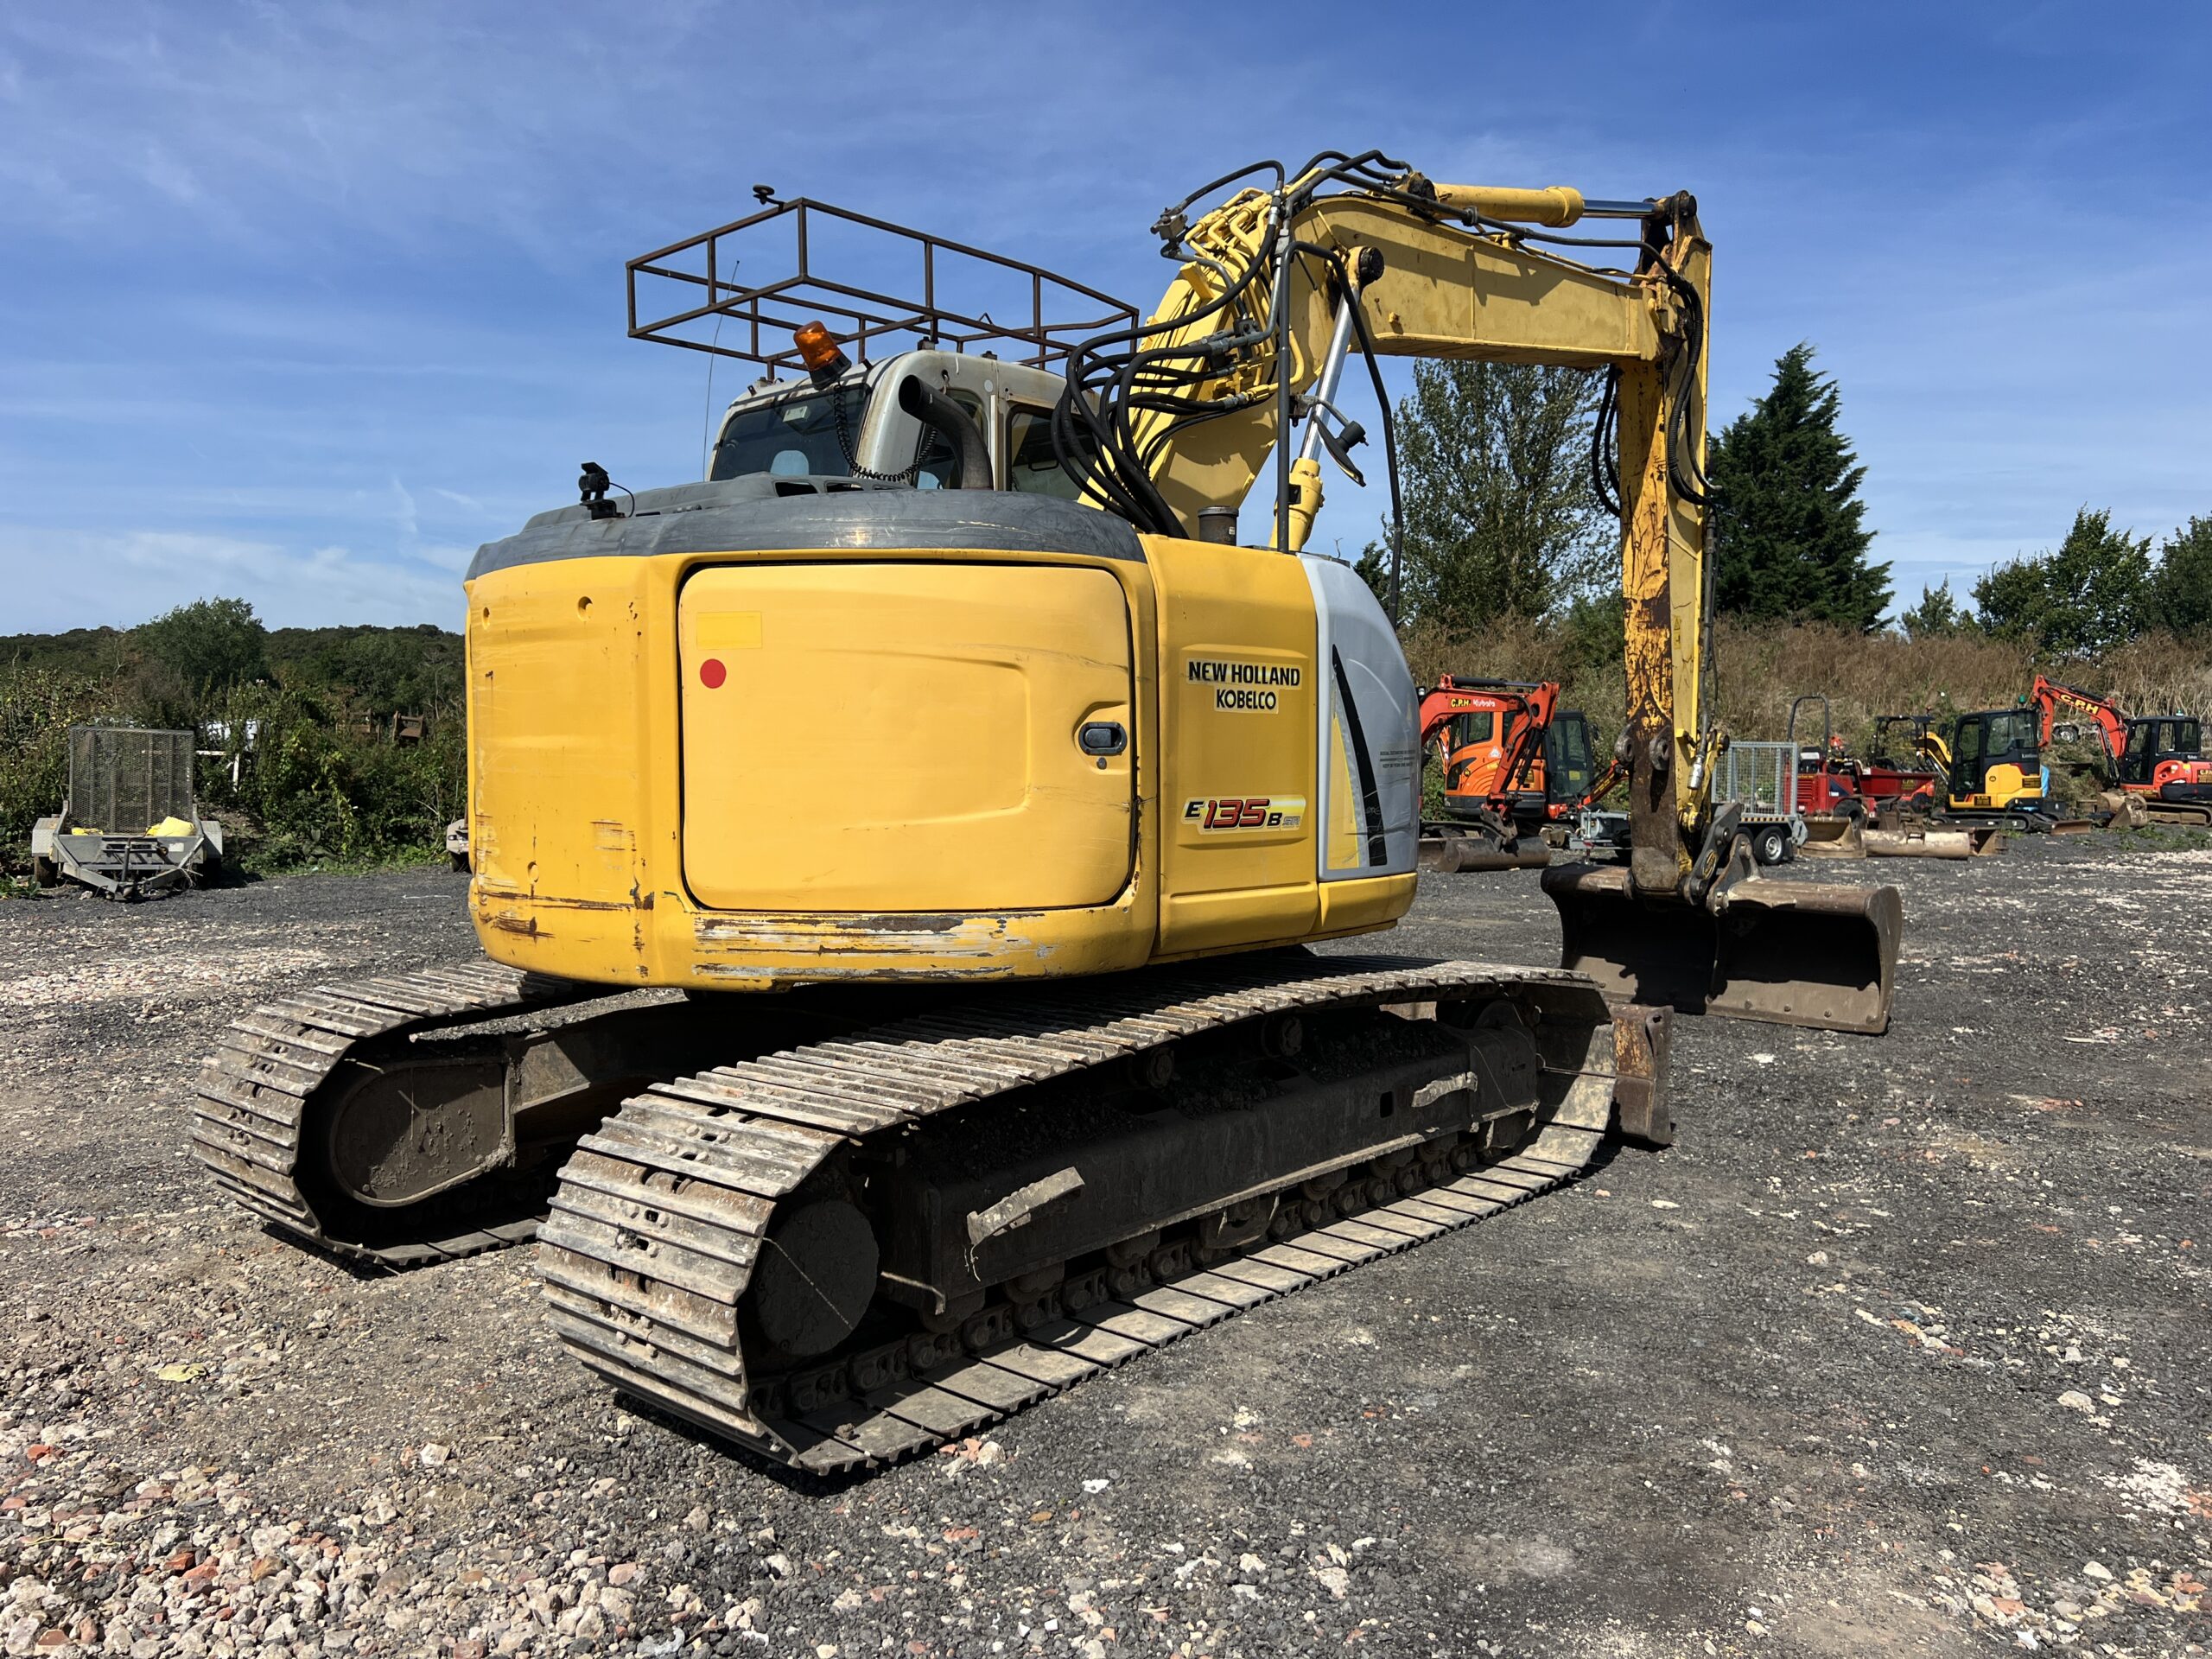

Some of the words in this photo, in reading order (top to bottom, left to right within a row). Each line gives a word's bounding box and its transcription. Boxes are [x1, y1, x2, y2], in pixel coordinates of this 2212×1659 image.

[1188, 661, 1227, 682] NEW
[1231, 664, 1300, 686] HOLLAND
[1216, 689, 1276, 709] KOBELCO
